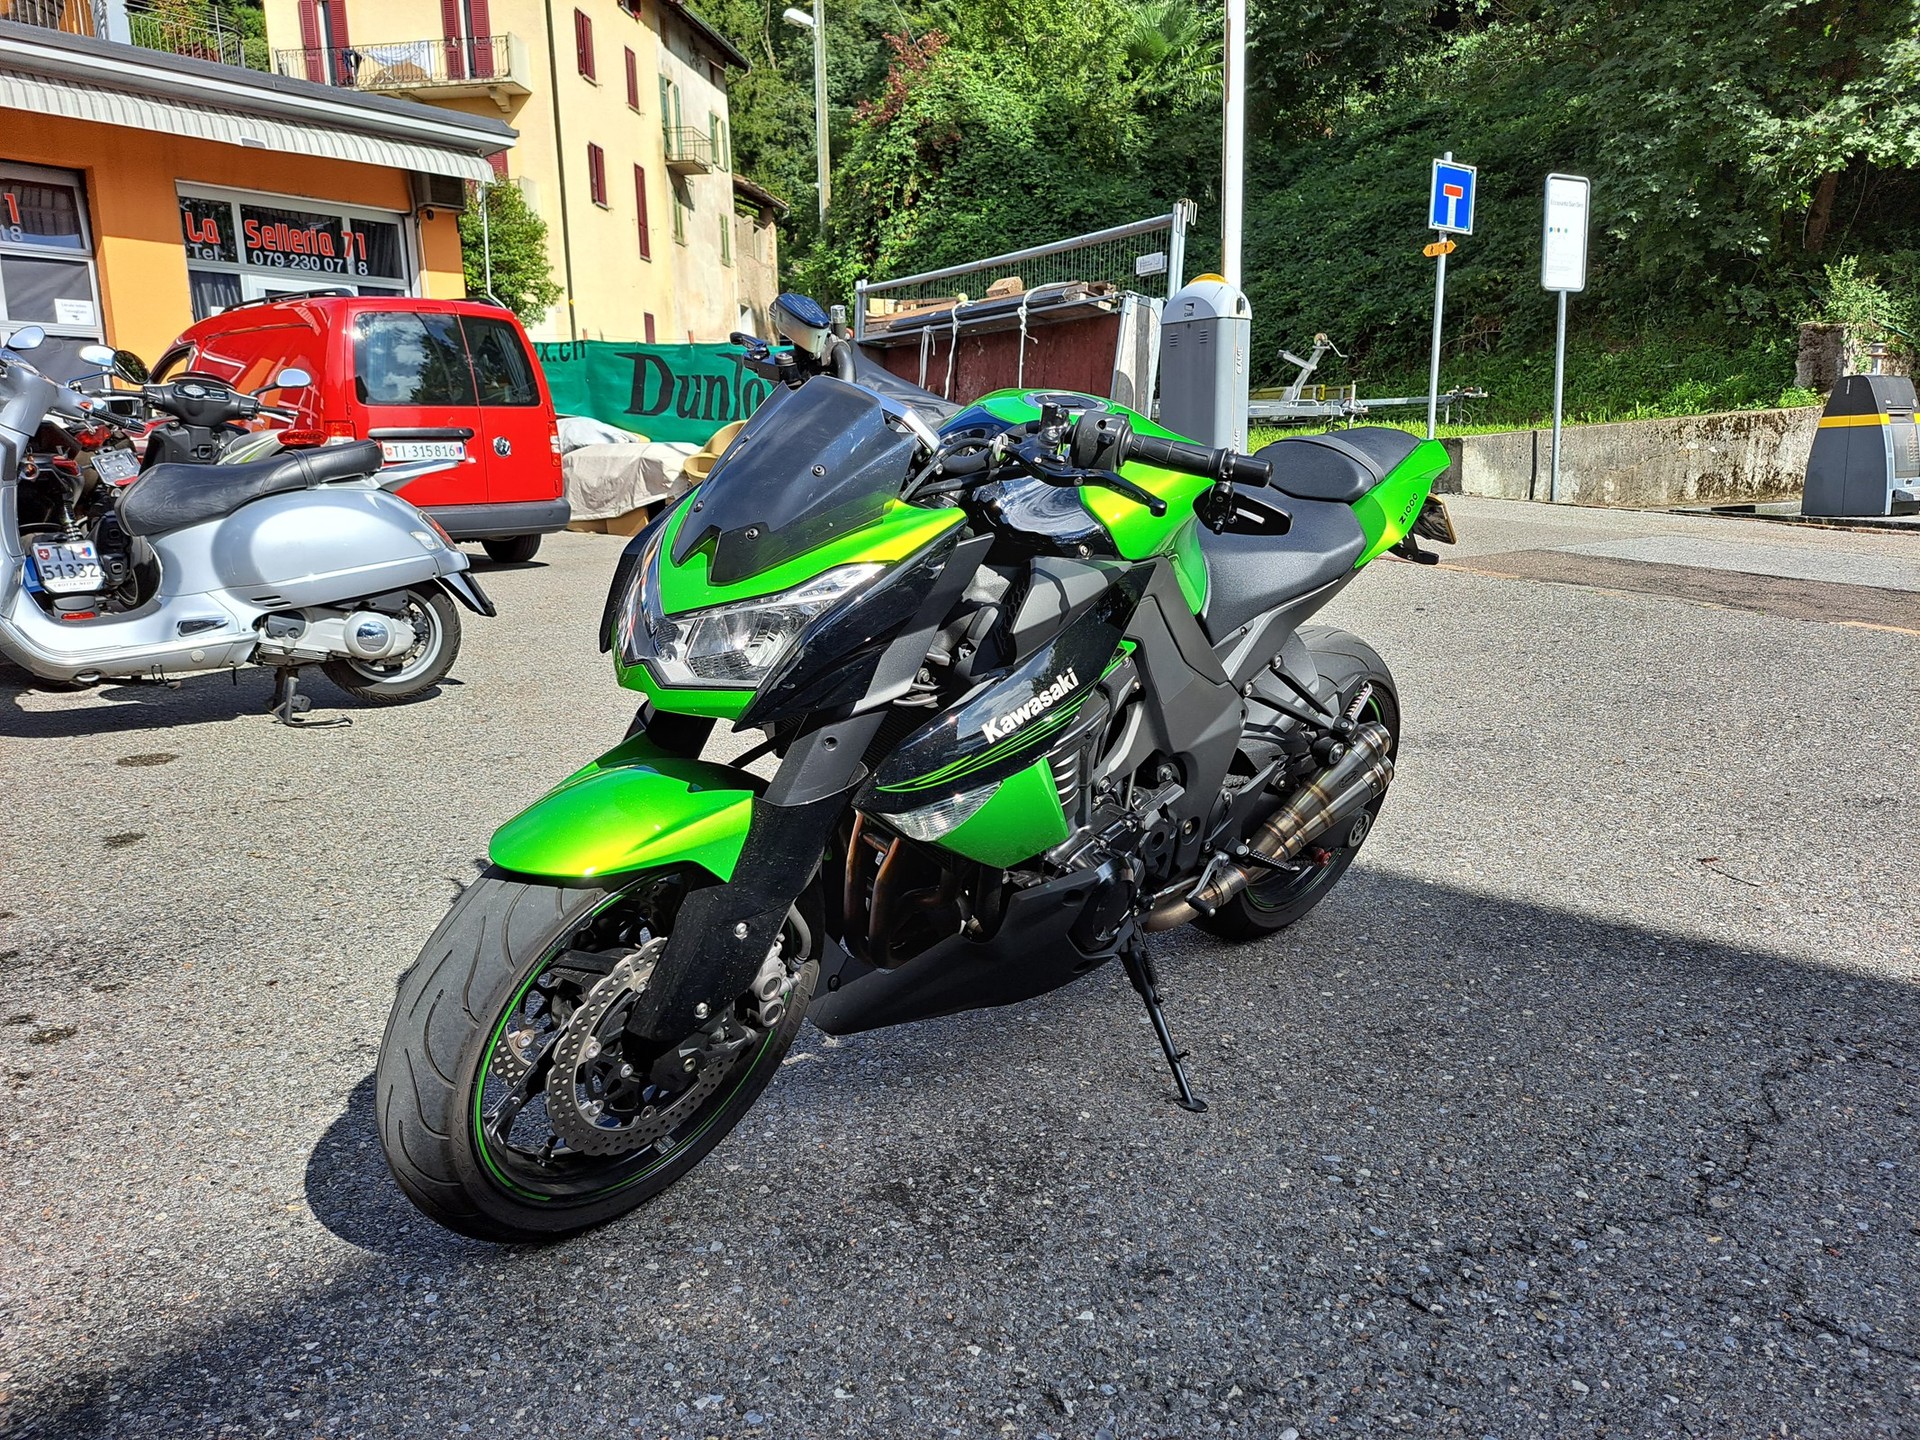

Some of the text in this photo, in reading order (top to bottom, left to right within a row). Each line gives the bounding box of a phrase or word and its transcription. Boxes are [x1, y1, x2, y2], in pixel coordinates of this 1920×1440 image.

[184, 211, 366, 260] La Selleria 71
[190, 243, 225, 261] Tel.
[253, 250, 285, 268] 079
[290, 254, 320, 271] 230
[614, 352, 779, 421] Dunlo
[1398, 493, 1419, 525] Z1000
[43, 562, 99, 581] 51332
[981, 667, 1079, 744] Kawasaki
